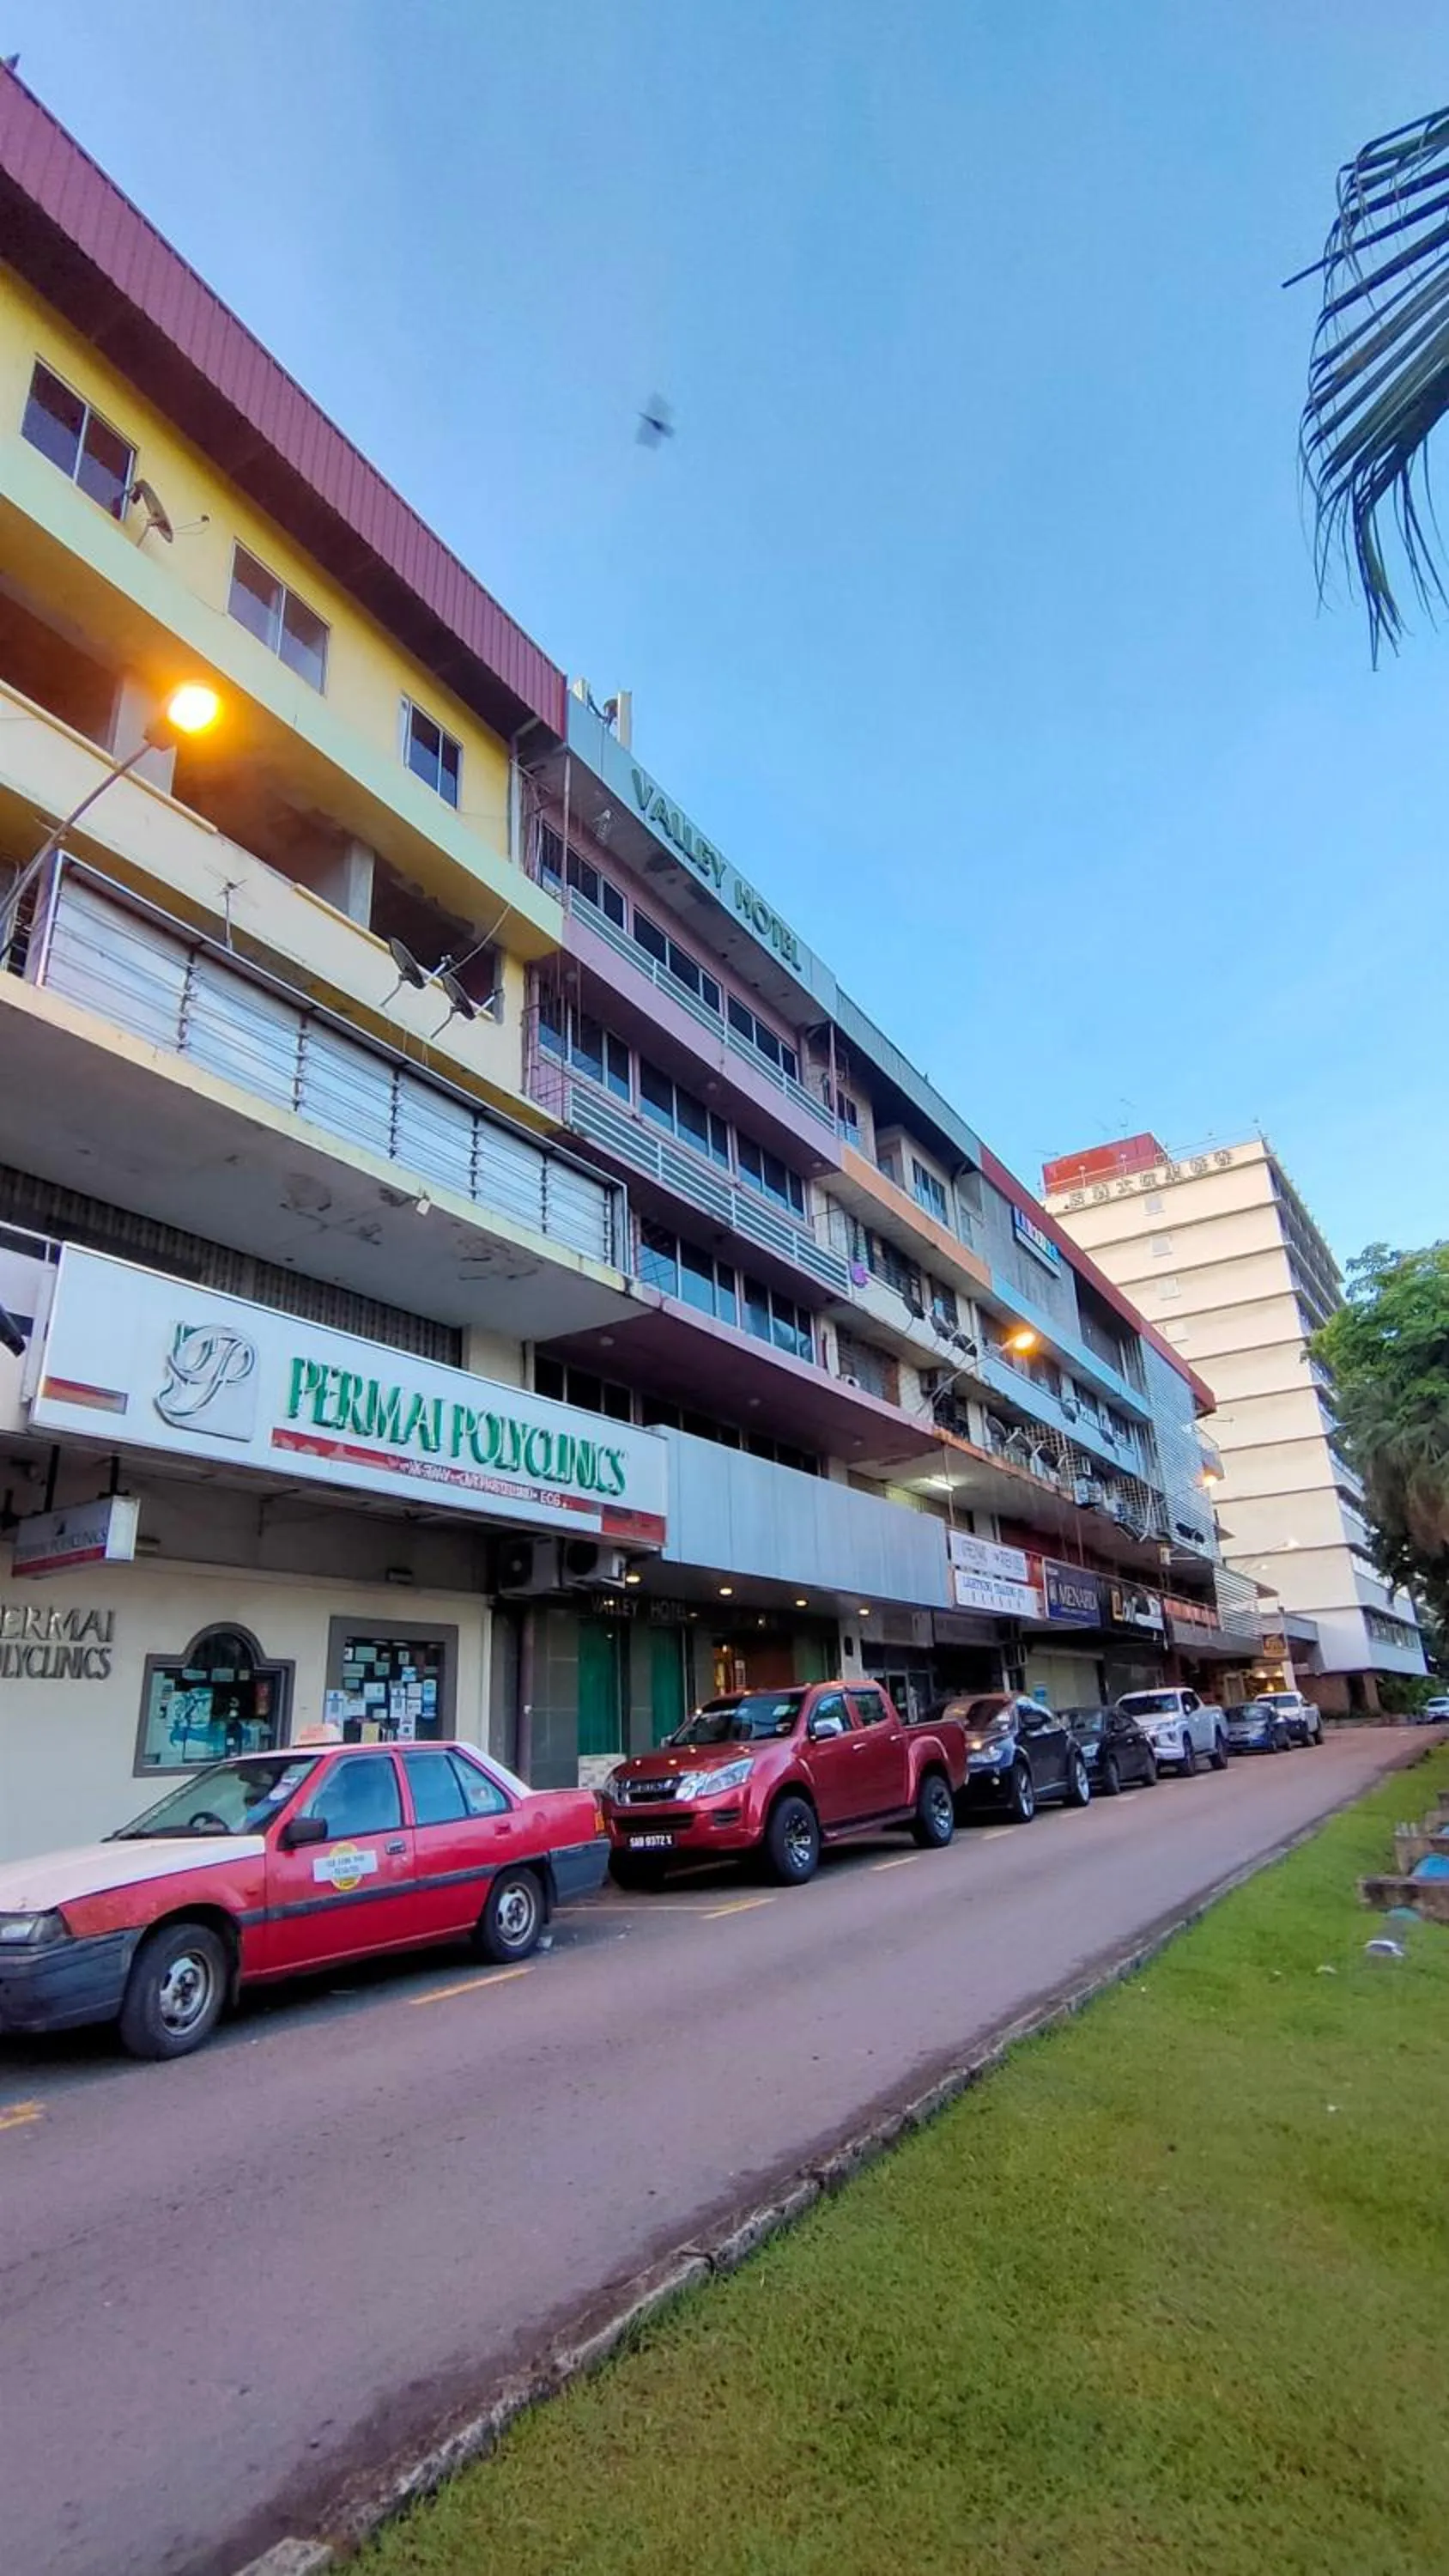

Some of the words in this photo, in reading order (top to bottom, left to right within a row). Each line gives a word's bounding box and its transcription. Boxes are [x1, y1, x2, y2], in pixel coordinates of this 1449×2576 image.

[632, 769, 726, 888] VALLEY
[734, 878, 802, 972] HOTEL
[288, 1357, 445, 1453] PERMAI
[451, 1403, 627, 1496] POLYCLINICS
[650, 1599, 688, 1621] HOTEL
